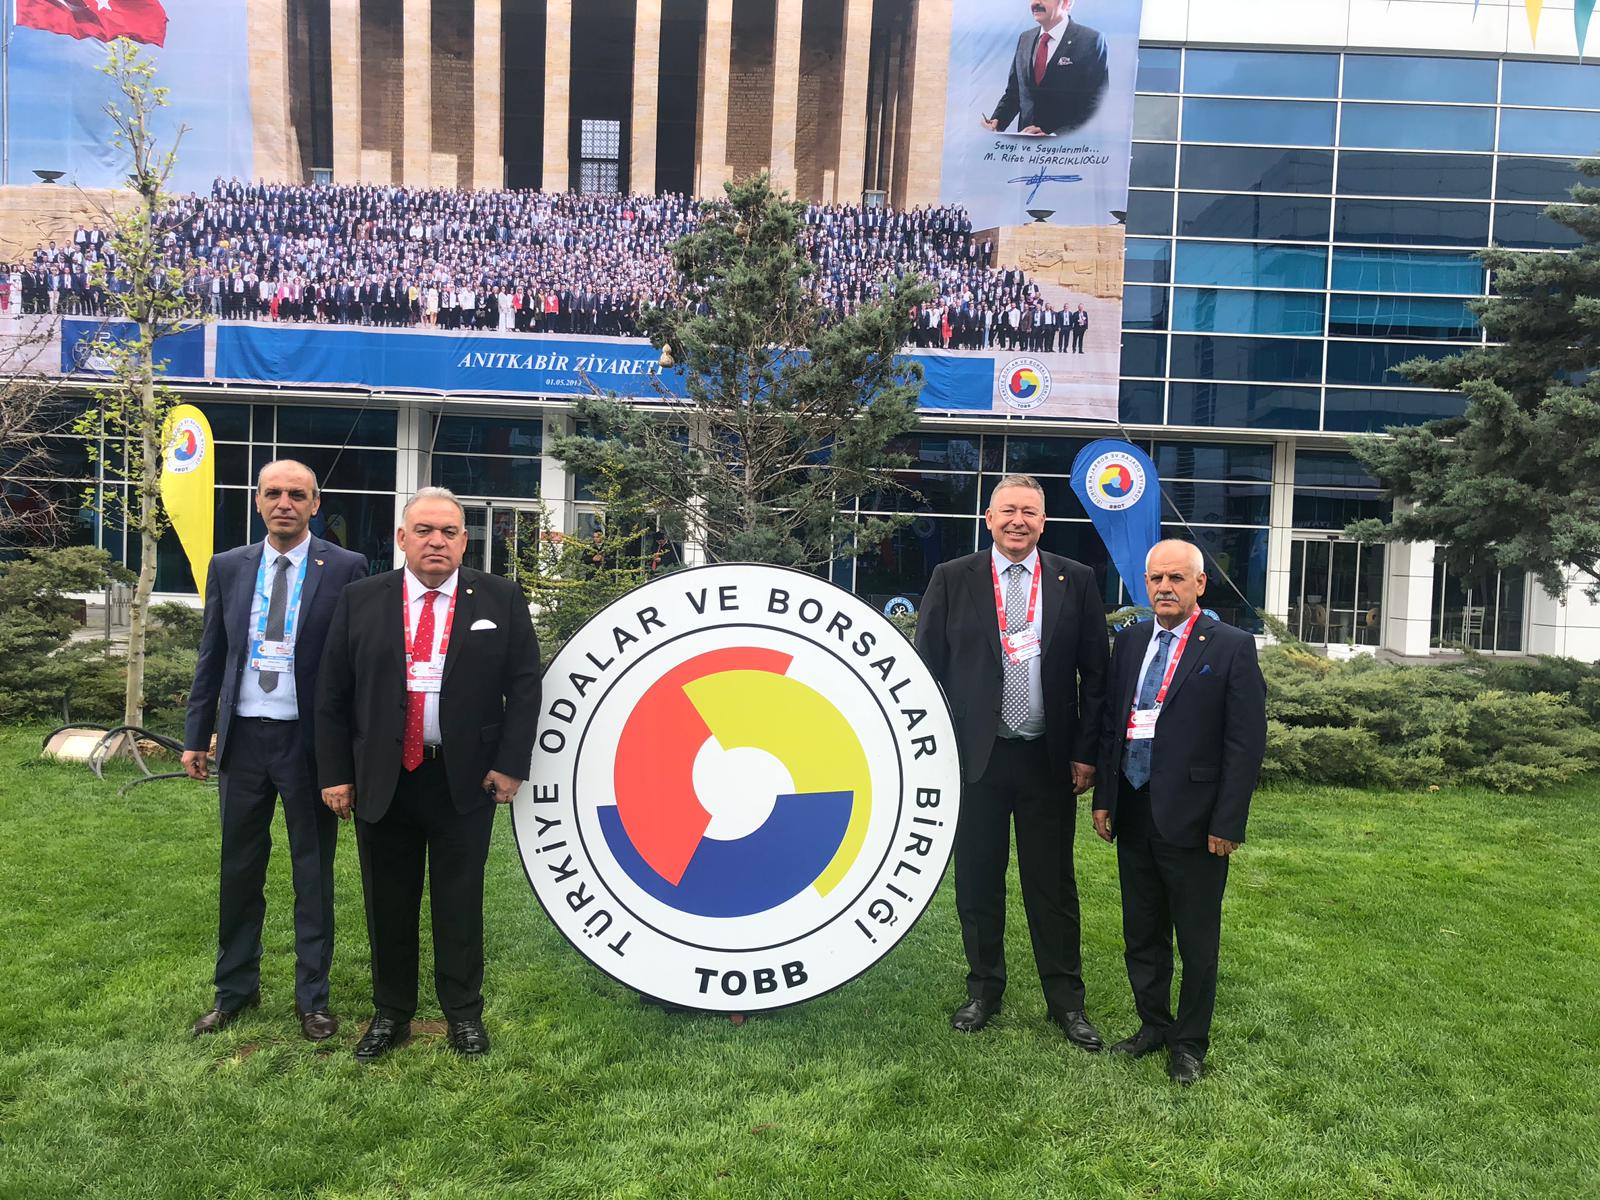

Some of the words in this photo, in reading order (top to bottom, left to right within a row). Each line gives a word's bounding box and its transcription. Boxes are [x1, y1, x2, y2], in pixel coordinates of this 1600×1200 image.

[984, 153, 996, 161] M.
[1001, 153, 1024, 163] Rifat
[1028, 154, 1109, 165] HİSARCIKLIOĞLU
[994, 141, 1017, 153] Sevgi
[457, 351, 570, 371] ANITKABİR
[686, 586, 738, 614] VE
[539, 607, 665, 753] ODALAR
[768, 588, 936, 760] BORSALAR
[533, 784, 631, 957] TÜRKİYE
[855, 788, 943, 943] BİRLİĞİ
[695, 961, 808, 995] TOBB
